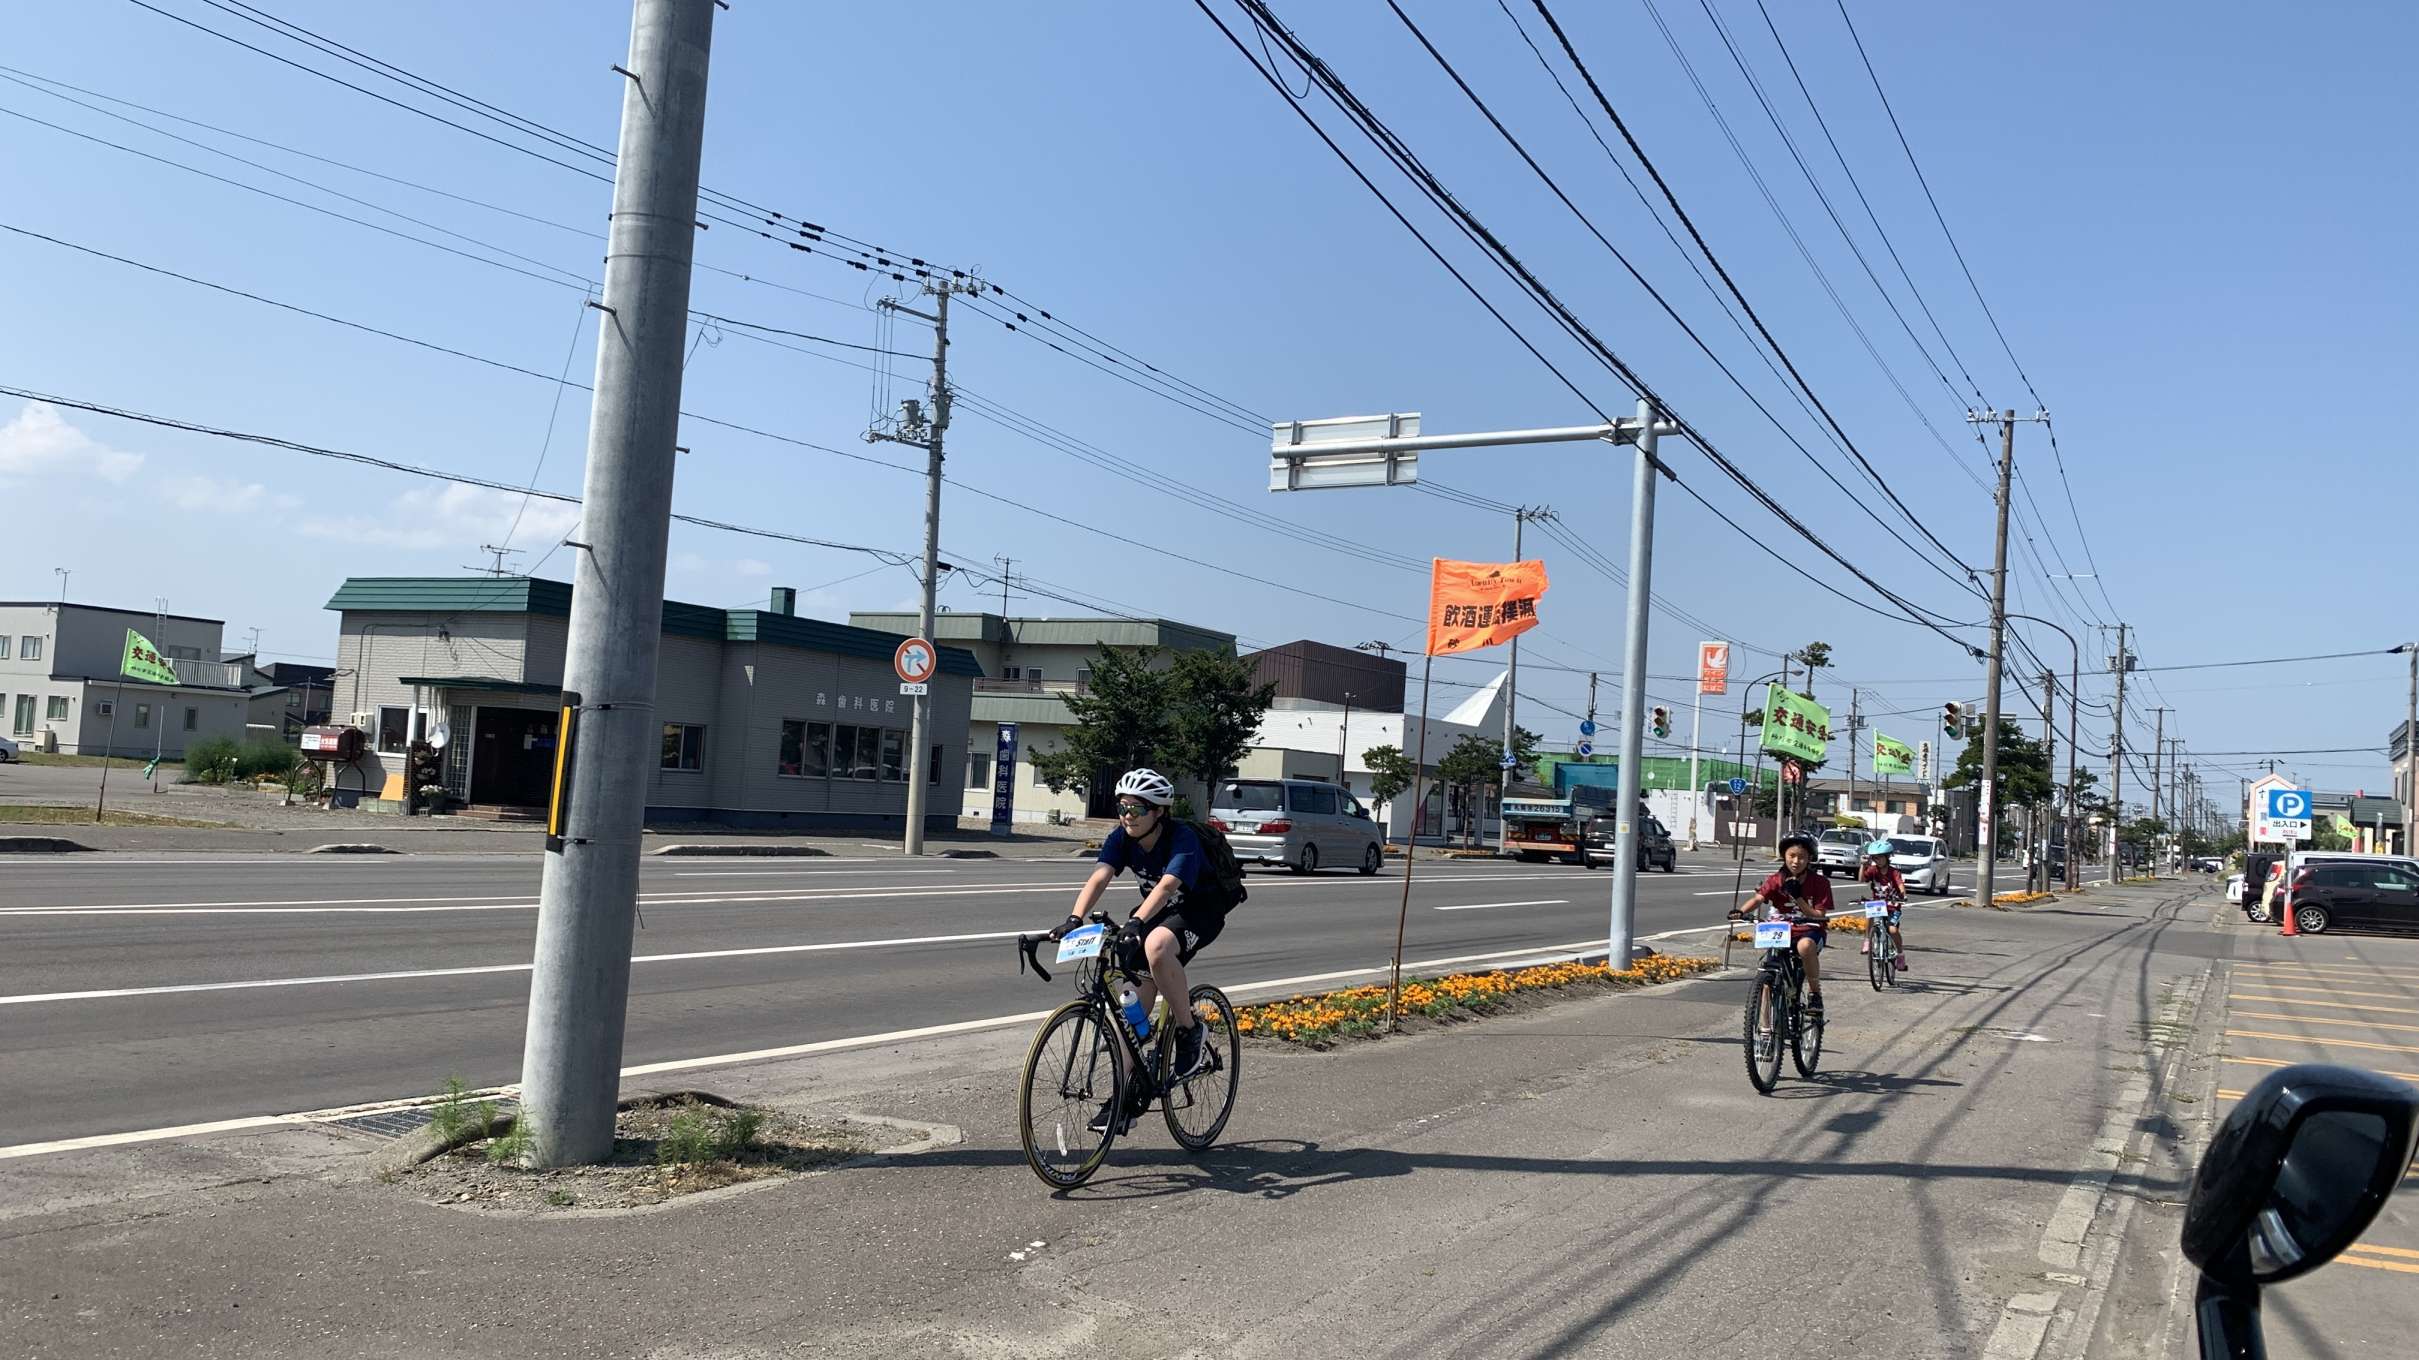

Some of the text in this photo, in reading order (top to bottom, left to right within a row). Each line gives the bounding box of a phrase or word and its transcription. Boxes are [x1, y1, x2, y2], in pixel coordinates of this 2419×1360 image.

[131, 645, 176, 676] 交通
[2282, 797, 2300, 814] P
[2272, 821, 2298, 829] 出入口
